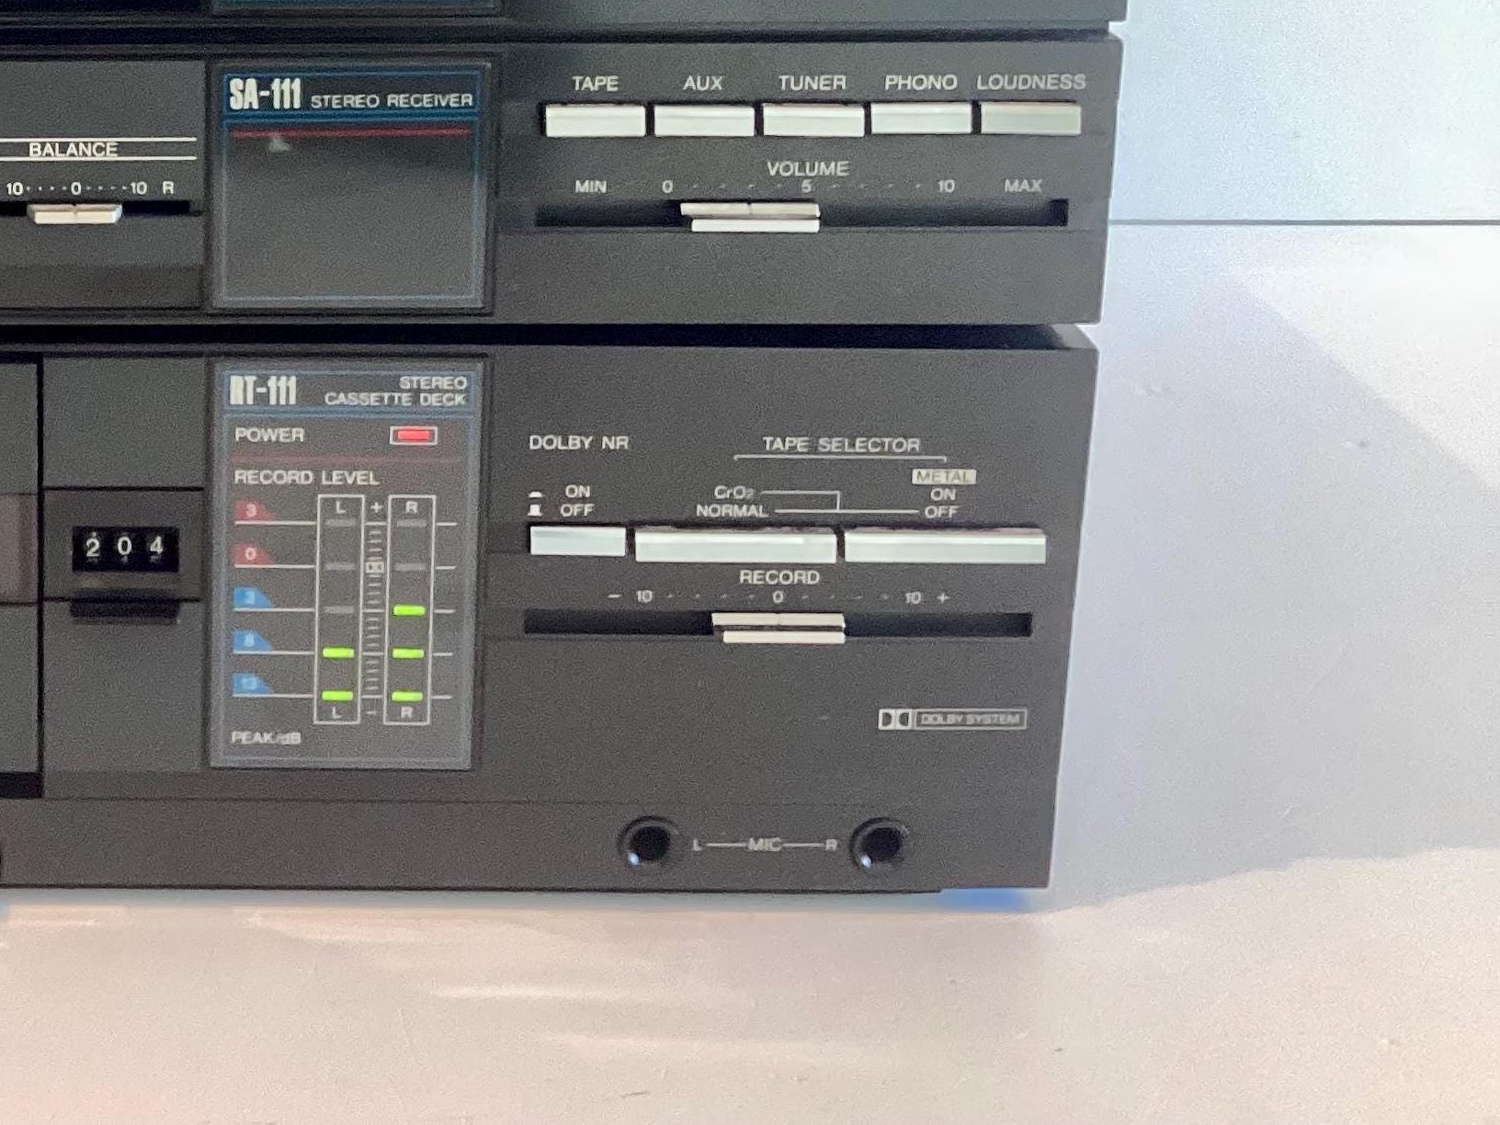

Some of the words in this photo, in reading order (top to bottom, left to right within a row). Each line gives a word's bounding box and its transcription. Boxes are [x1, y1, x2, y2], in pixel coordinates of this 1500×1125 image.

[572, 75, 619, 92] TAPE
[682, 75, 723, 92] AUX
[779, 74, 847, 91] TUNER
[884, 74, 958, 91] PHONO
[976, 73, 1087, 91] LOUDNESS
[229, 77, 301, 110] SA-111
[310, 94, 381, 109] STEREO
[386, 93, 473, 108] RECEIVER
[28, 141, 119, 158] BALANCE
[767, 160, 849, 177] VOLUME
[5, 181, 24, 196] 10
[130, 181, 147, 196] 10
[575, 179, 607, 194] MIN
[662, 179, 673, 194] 0
[801, 179, 813, 194] 5
[937, 179, 956, 194] 10
[1004, 178, 1043, 193] MAX
[400, 375, 468, 390] STEREO
[324, 391, 412, 407] CASSETTE
[419, 392, 466, 407] DECK
[234, 426, 305, 443] POWER
[529, 434, 594, 451] DOLBY
[601, 435, 629, 450] NR
[762, 436, 809, 453] TAPE
[818, 438, 920, 452] SELECTOR
[234, 469, 314, 485] RECORD
[321, 470, 380, 486] LEVEL
[916, 470, 972, 484] METAL
[564, 484, 591, 499] ON
[930, 487, 957, 502] ON
[246, 503, 257, 518] 3
[335, 500, 346, 515] L
[406, 501, 417, 513] R
[559, 503, 594, 518] OFF
[696, 503, 769, 518] NORMAL
[923, 504, 960, 519] OFF
[245, 549, 256, 561] 0
[739, 569, 821, 585] RECORD
[635, 590, 654, 604] 10
[905, 591, 923, 605] 10
[332, 707, 342, 719] L
[400, 706, 414, 719] R
[747, 836, 782, 852] MIC
